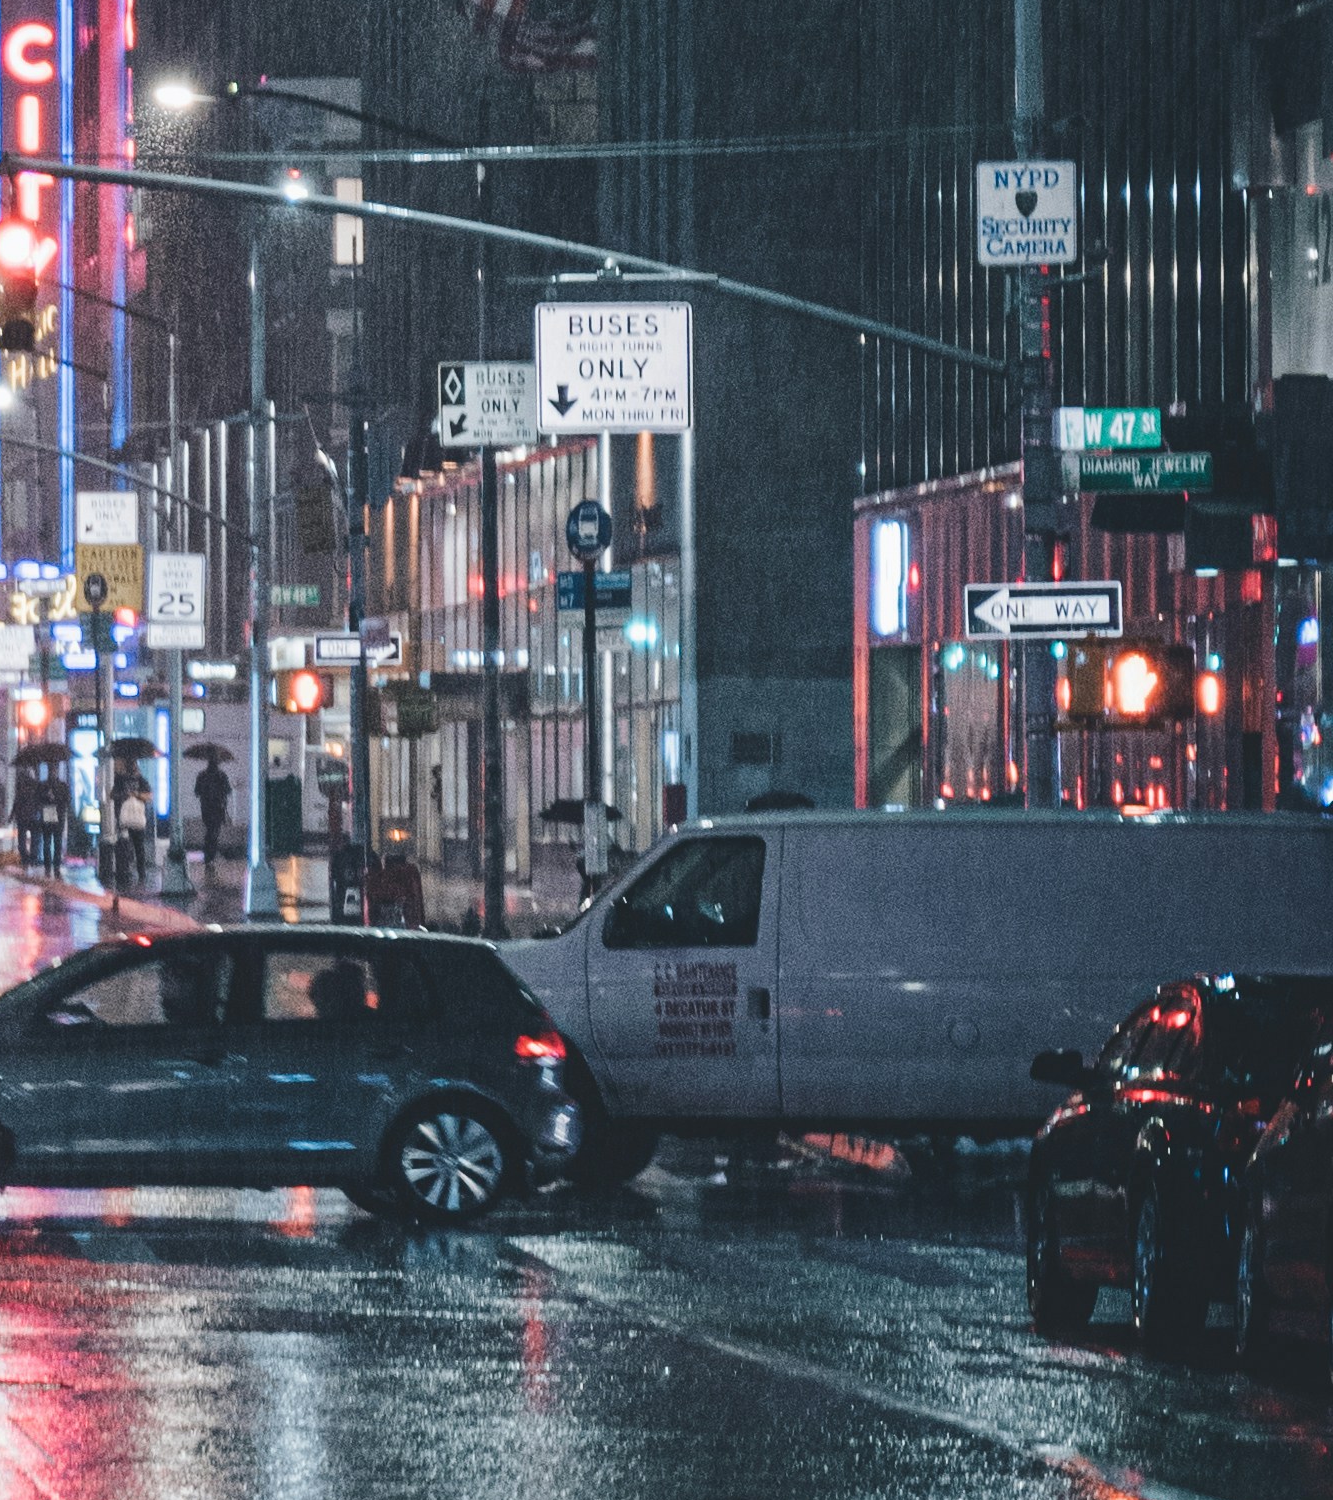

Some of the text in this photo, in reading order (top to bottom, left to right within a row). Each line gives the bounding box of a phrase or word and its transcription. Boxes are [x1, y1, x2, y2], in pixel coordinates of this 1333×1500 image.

[994, 168, 1059, 189] NYPD
[982, 216, 1071, 237] SECURITY
[986, 237, 1067, 257] CAMERA
[568, 314, 659, 336] BUSES
[579, 342, 615, 351] RIGHT
[621, 341, 663, 351] TURNS
[475, 369, 526, 386] BUSES
[578, 357, 649, 380] ONLY
[481, 398, 520, 413] ONLY
[582, 408, 685, 421] MON THRU FRI
[1084, 412, 1103, 445] W
[1109, 411, 1136, 445] 47
[1082, 455, 1207, 475] DIAMOND JEWELRY
[1133, 473, 1161, 488] WAY
[95, 510, 121, 521] ONLY
[157, 591, 196, 616] 25
[990, 599, 1099, 620] ONE WAY
